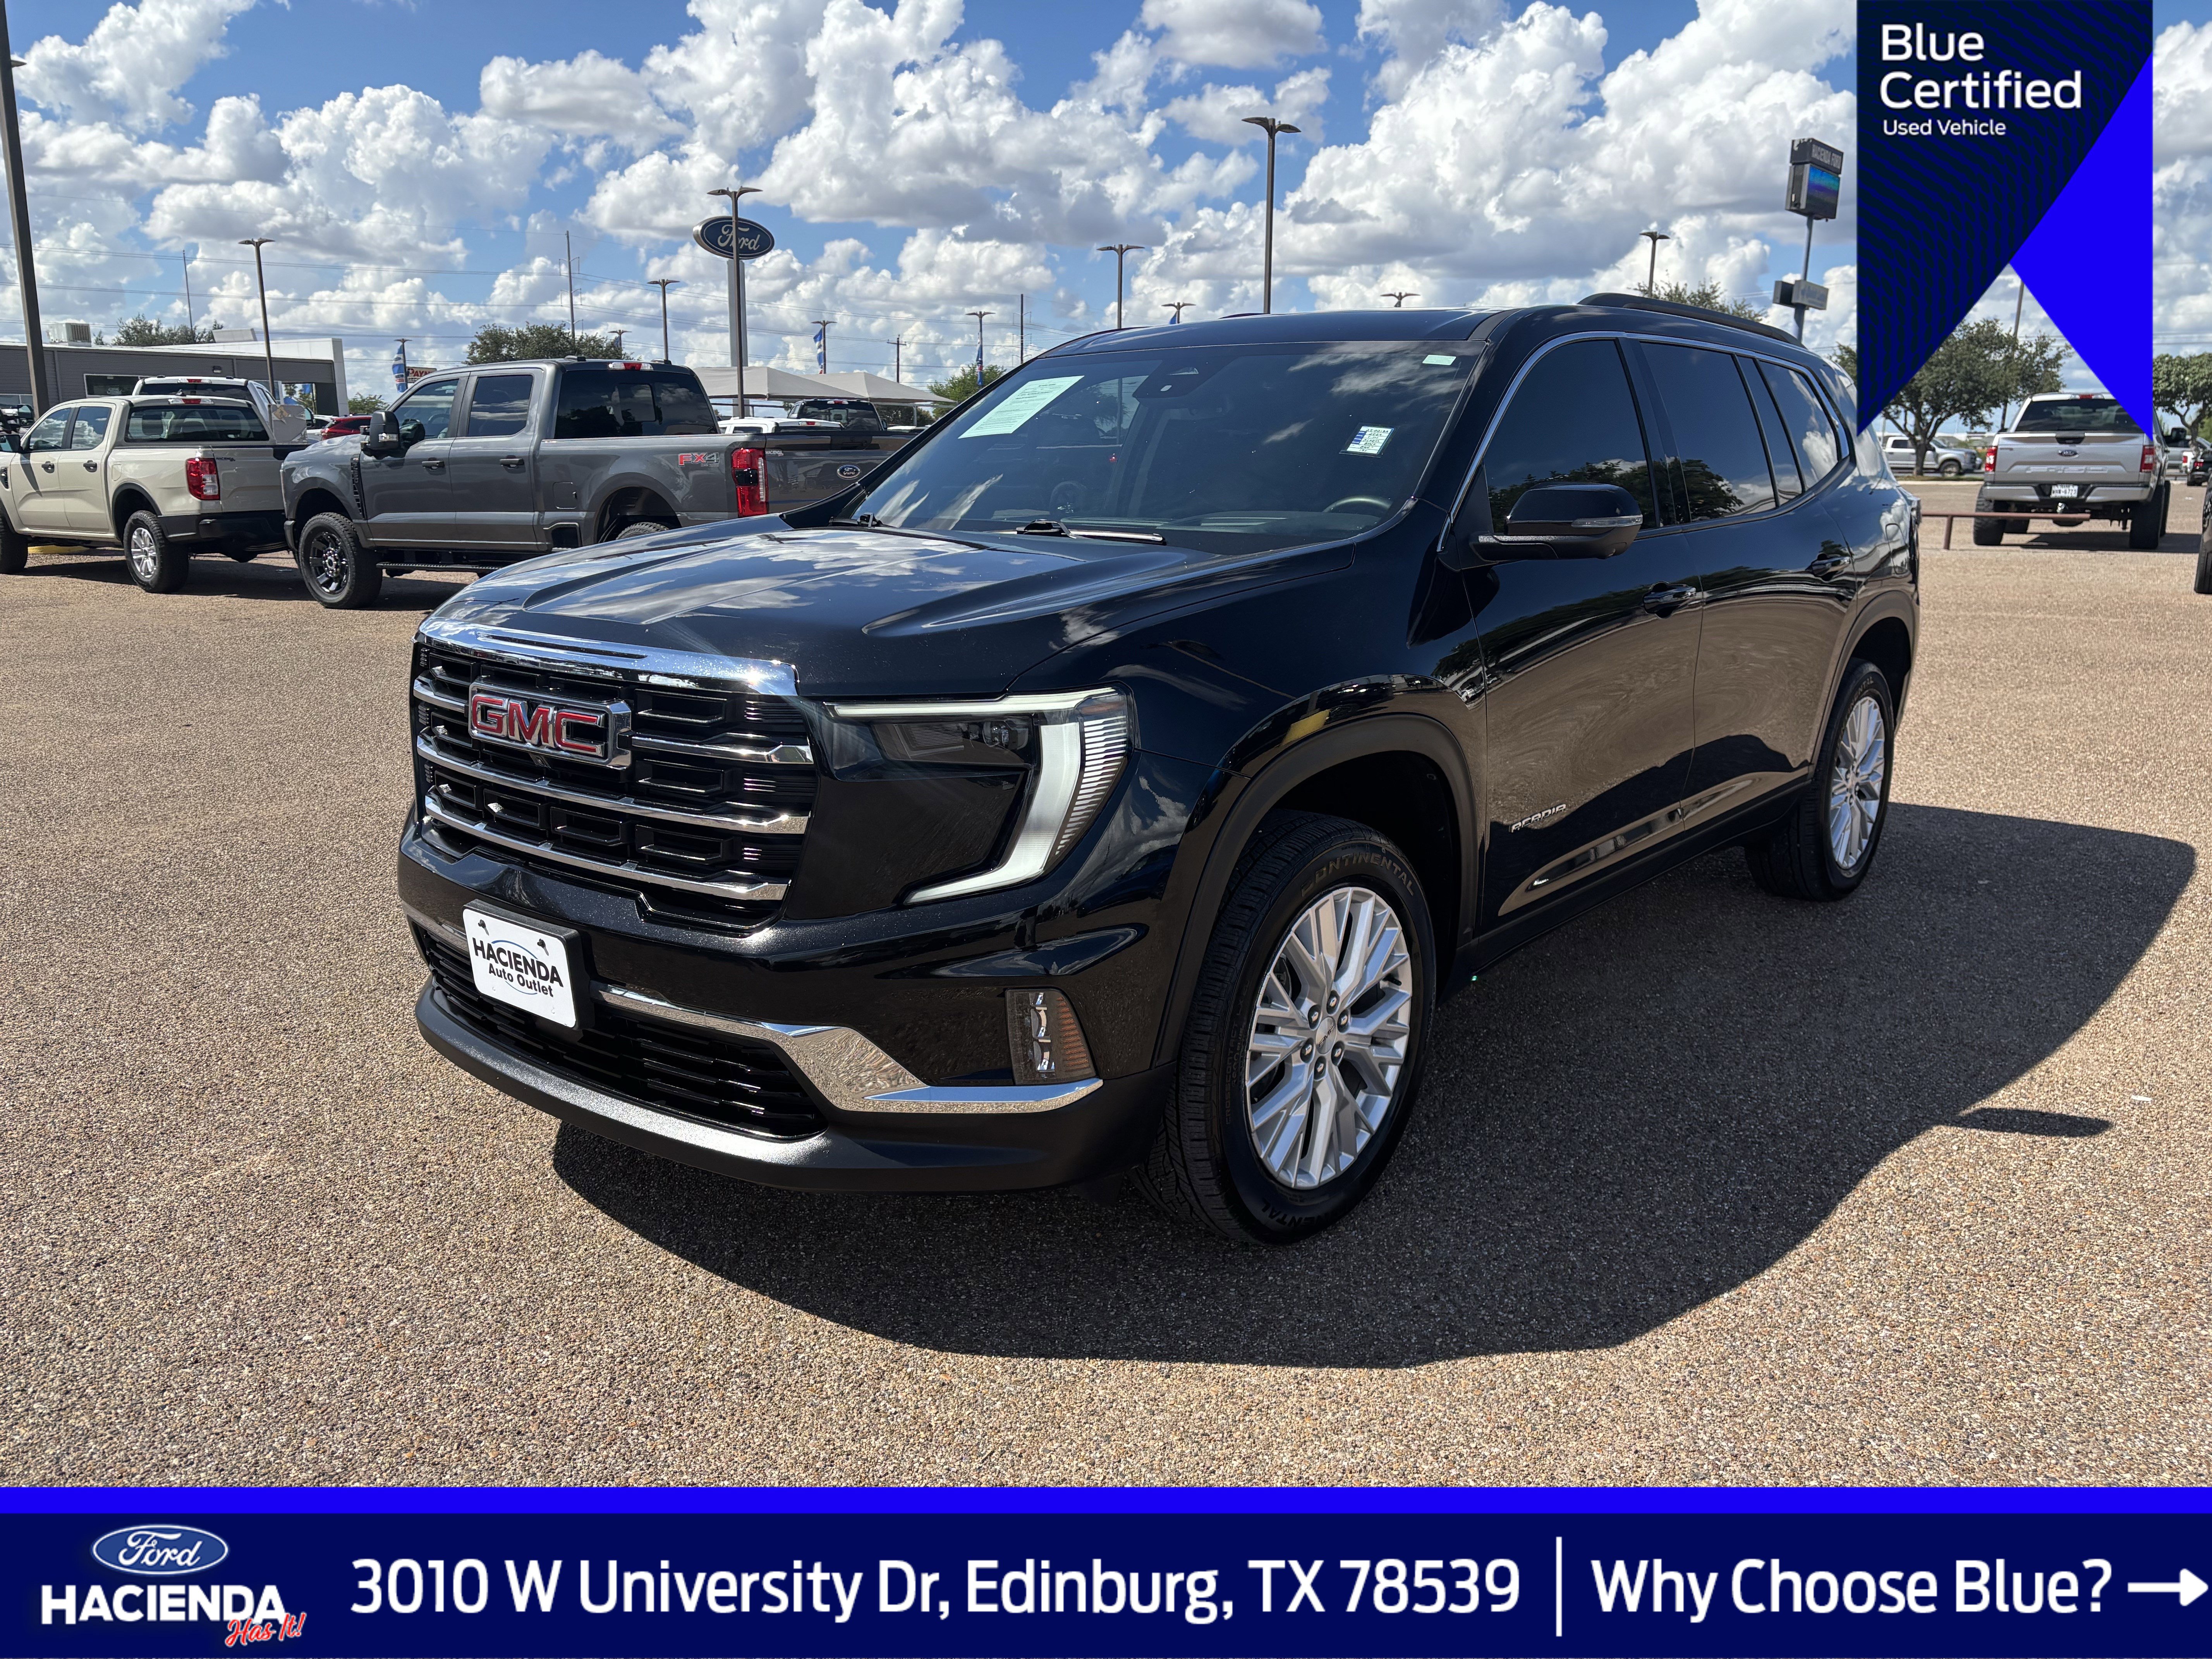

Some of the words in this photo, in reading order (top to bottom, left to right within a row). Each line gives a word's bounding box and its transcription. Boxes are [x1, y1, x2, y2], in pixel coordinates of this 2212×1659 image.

[717, 224, 761, 251] Frd
[678, 452, 719, 466] FX4
[472, 695, 603, 756] GMC
[1509, 804, 1566, 833] ACADIA
[1300, 852, 1414, 898] CONTINENTAL
[472, 937, 564, 988] HACIENDA
[488, 963, 514, 983] Auto
[517, 974, 554, 998] Outlet
